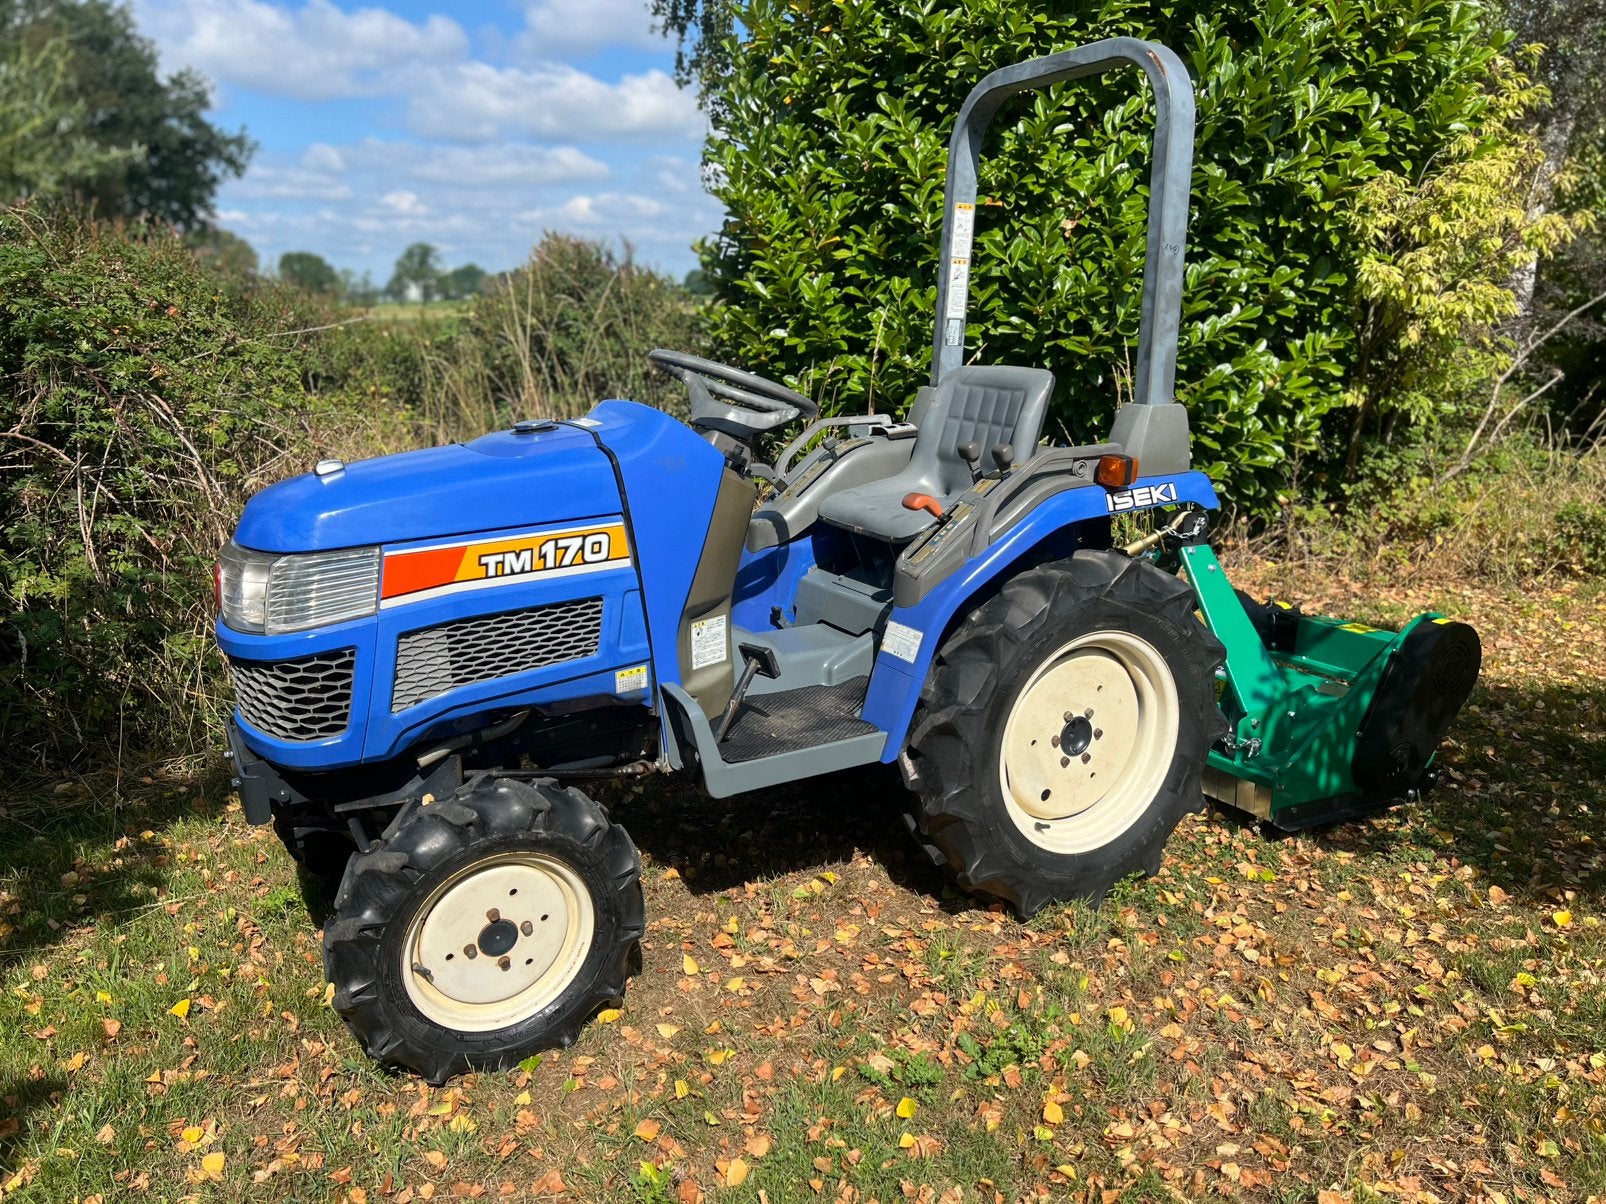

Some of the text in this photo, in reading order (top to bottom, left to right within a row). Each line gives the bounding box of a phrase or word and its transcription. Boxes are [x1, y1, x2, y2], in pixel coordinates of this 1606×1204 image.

[1106, 483, 1177, 512] ISEKI
[479, 532, 610, 578] TM 170
